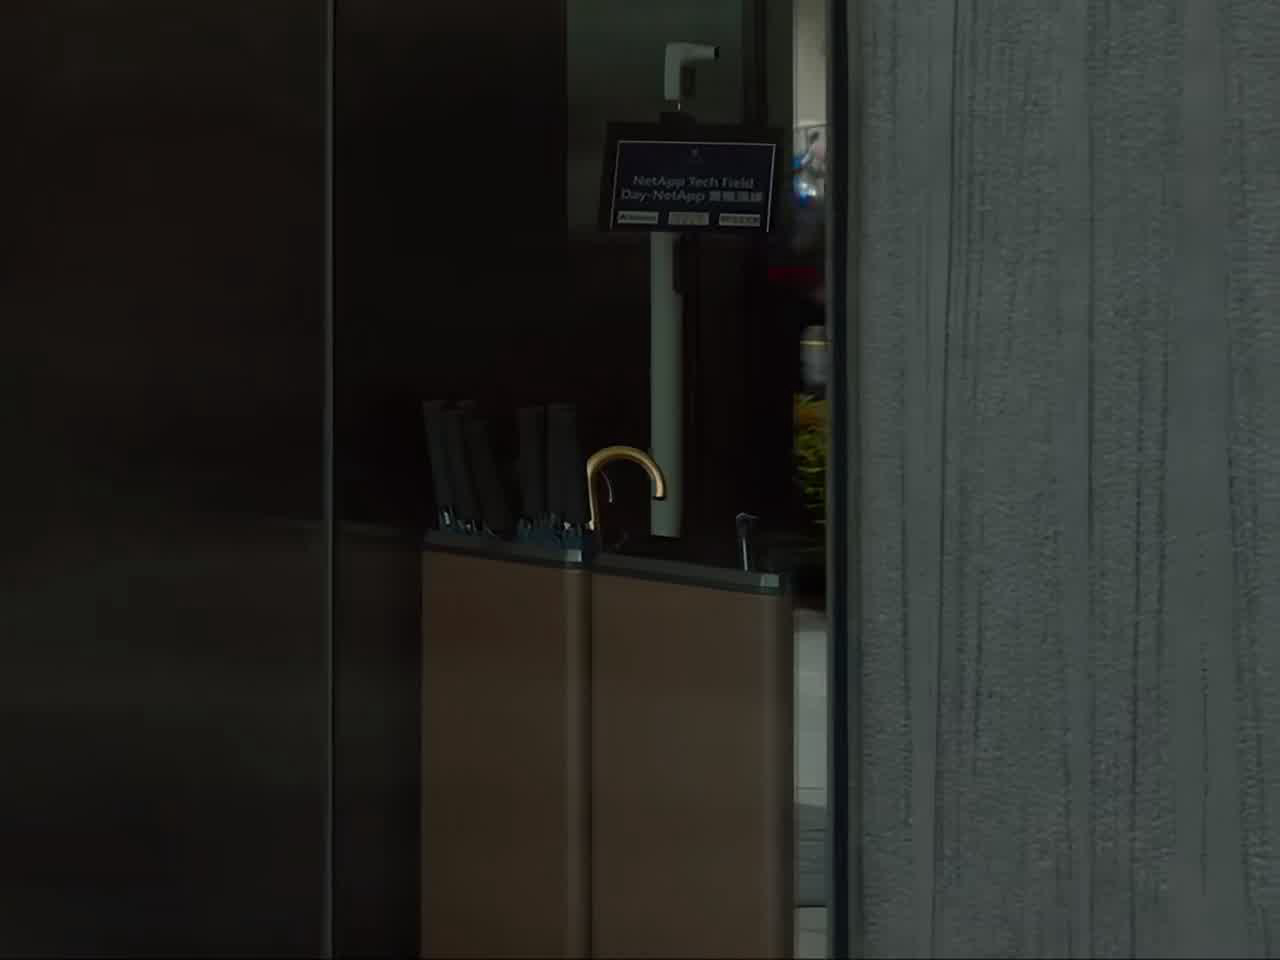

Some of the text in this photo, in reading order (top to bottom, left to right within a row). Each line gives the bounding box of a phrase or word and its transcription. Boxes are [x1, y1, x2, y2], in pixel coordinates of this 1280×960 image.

[632, 175, 755, 190] NetApp Tech Field
